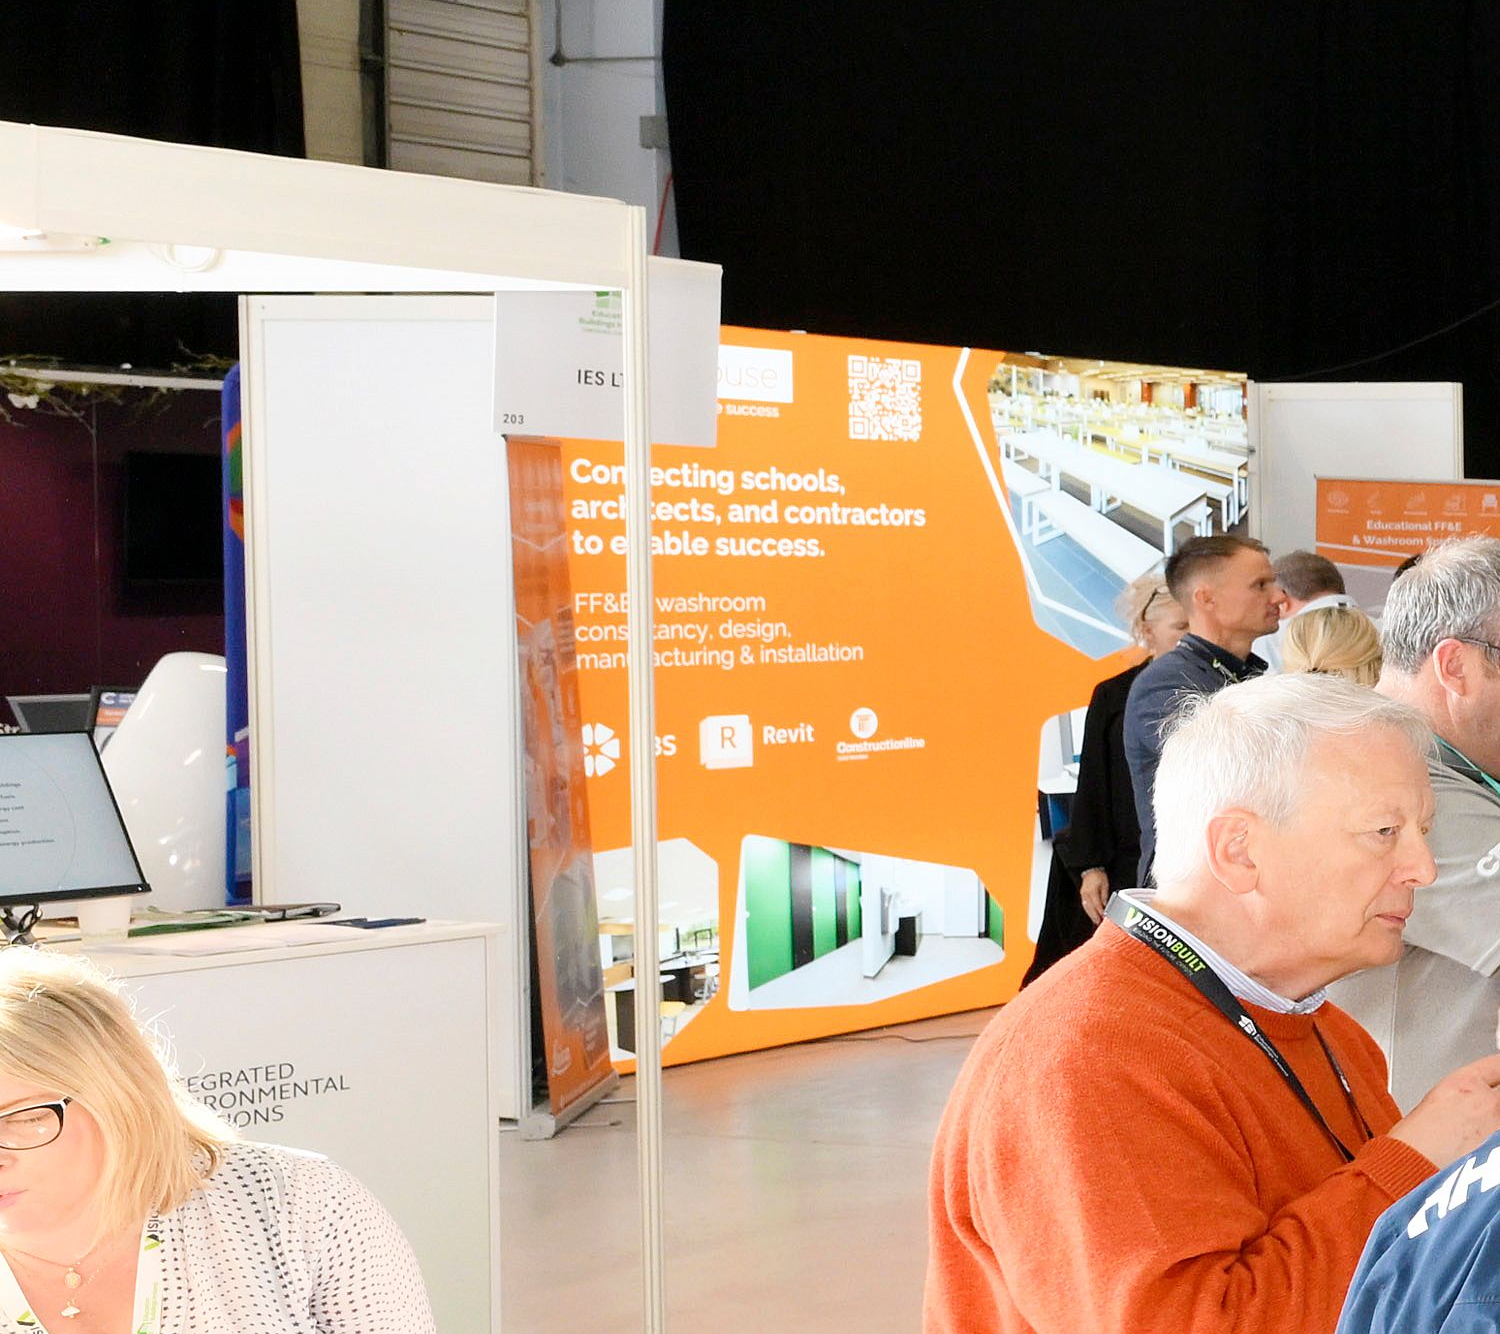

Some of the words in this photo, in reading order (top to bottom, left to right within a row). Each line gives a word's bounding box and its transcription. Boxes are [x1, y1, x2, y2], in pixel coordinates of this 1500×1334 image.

[577, 369, 604, 386] IES
[503, 413, 524, 425] 203
[726, 403, 780, 418] success
[570, 458, 734, 495] Conecting
[740, 464, 846, 496] schools,
[728, 500, 778, 525] and
[784, 504, 926, 527] contractors
[1367, 520, 1432, 532] Educational
[1435, 521, 1462, 531] FF&E
[573, 530, 604, 555] to
[610, 531, 709, 556] eable
[716, 536, 825, 558] success.
[1352, 535, 1361, 545] &
[1363, 535, 1424, 546] Washroom
[656, 593, 766, 613] washroom
[575, 619, 714, 644] constancy,
[576, 646, 735, 671] manacturing
[740, 646, 755, 665] &
[760, 643, 864, 664] installation
[653, 734, 677, 756] BS
[720, 725, 736, 749] R
[762, 723, 815, 745] Revit
[836, 736, 926, 754] Constructionline
[1123, 907, 1206, 973] VISIONBUILT
[187, 1063, 294, 1094] EGRATED
[198, 1075, 350, 1111] RONMENTAL
